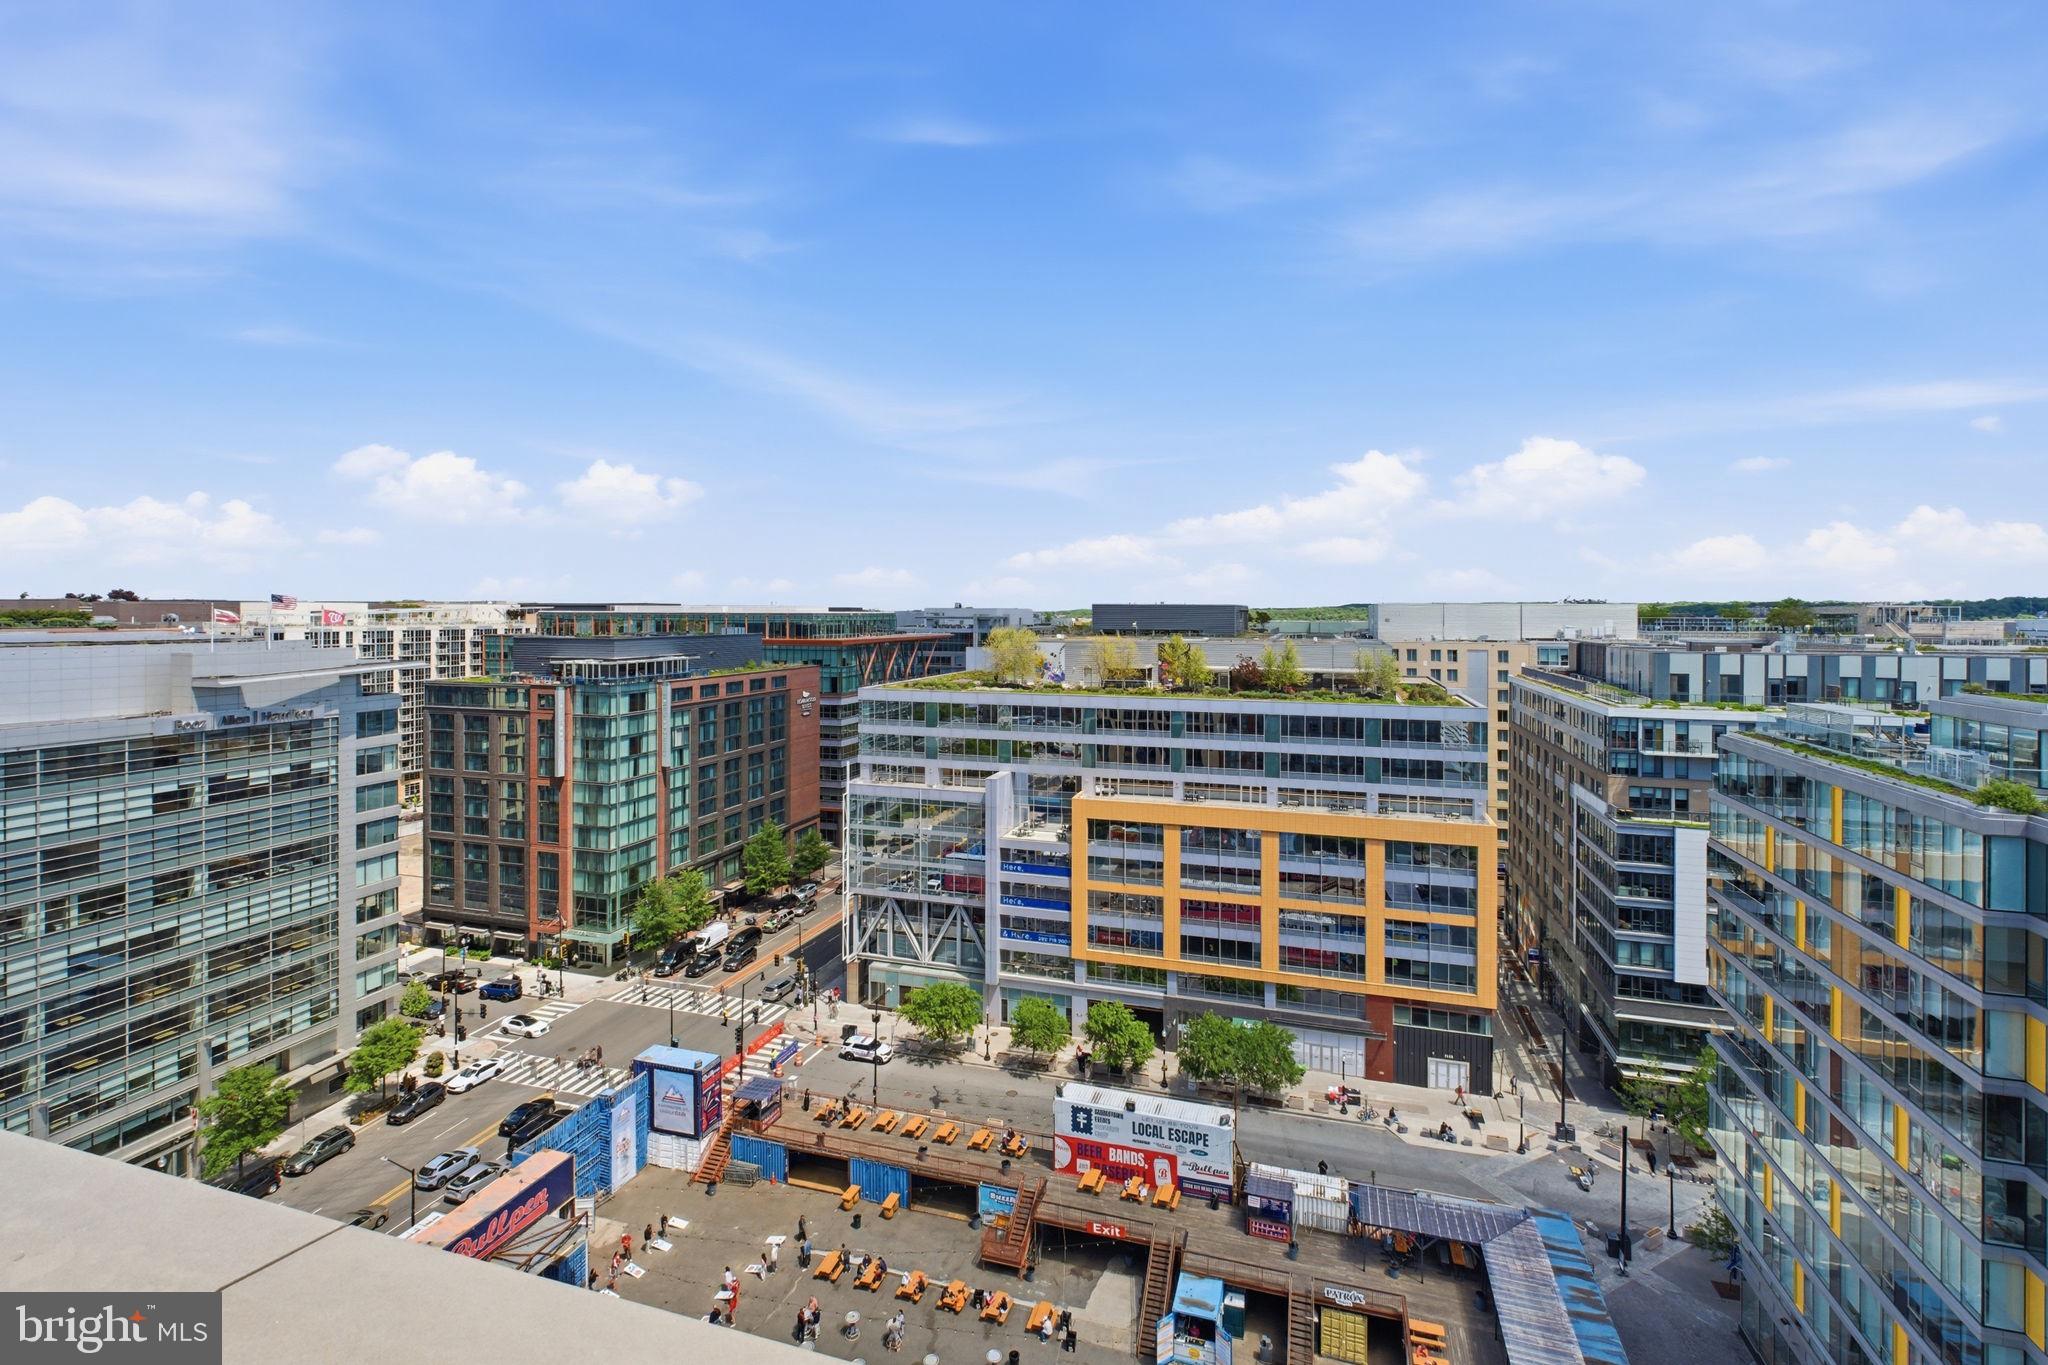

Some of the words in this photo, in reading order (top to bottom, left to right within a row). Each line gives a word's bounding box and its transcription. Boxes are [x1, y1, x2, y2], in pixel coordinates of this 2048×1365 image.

[174, 719, 207, 730] Booz
[220, 714, 250, 726] Allen
[1132, 1121, 1165, 1140] LOCAL
[1168, 1127, 1209, 1148] ESCAPE
[1188, 1161, 1230, 1176] Bullpen
[453, 1187, 549, 1256] Bullpen
[1093, 1223, 1121, 1237] Exit
